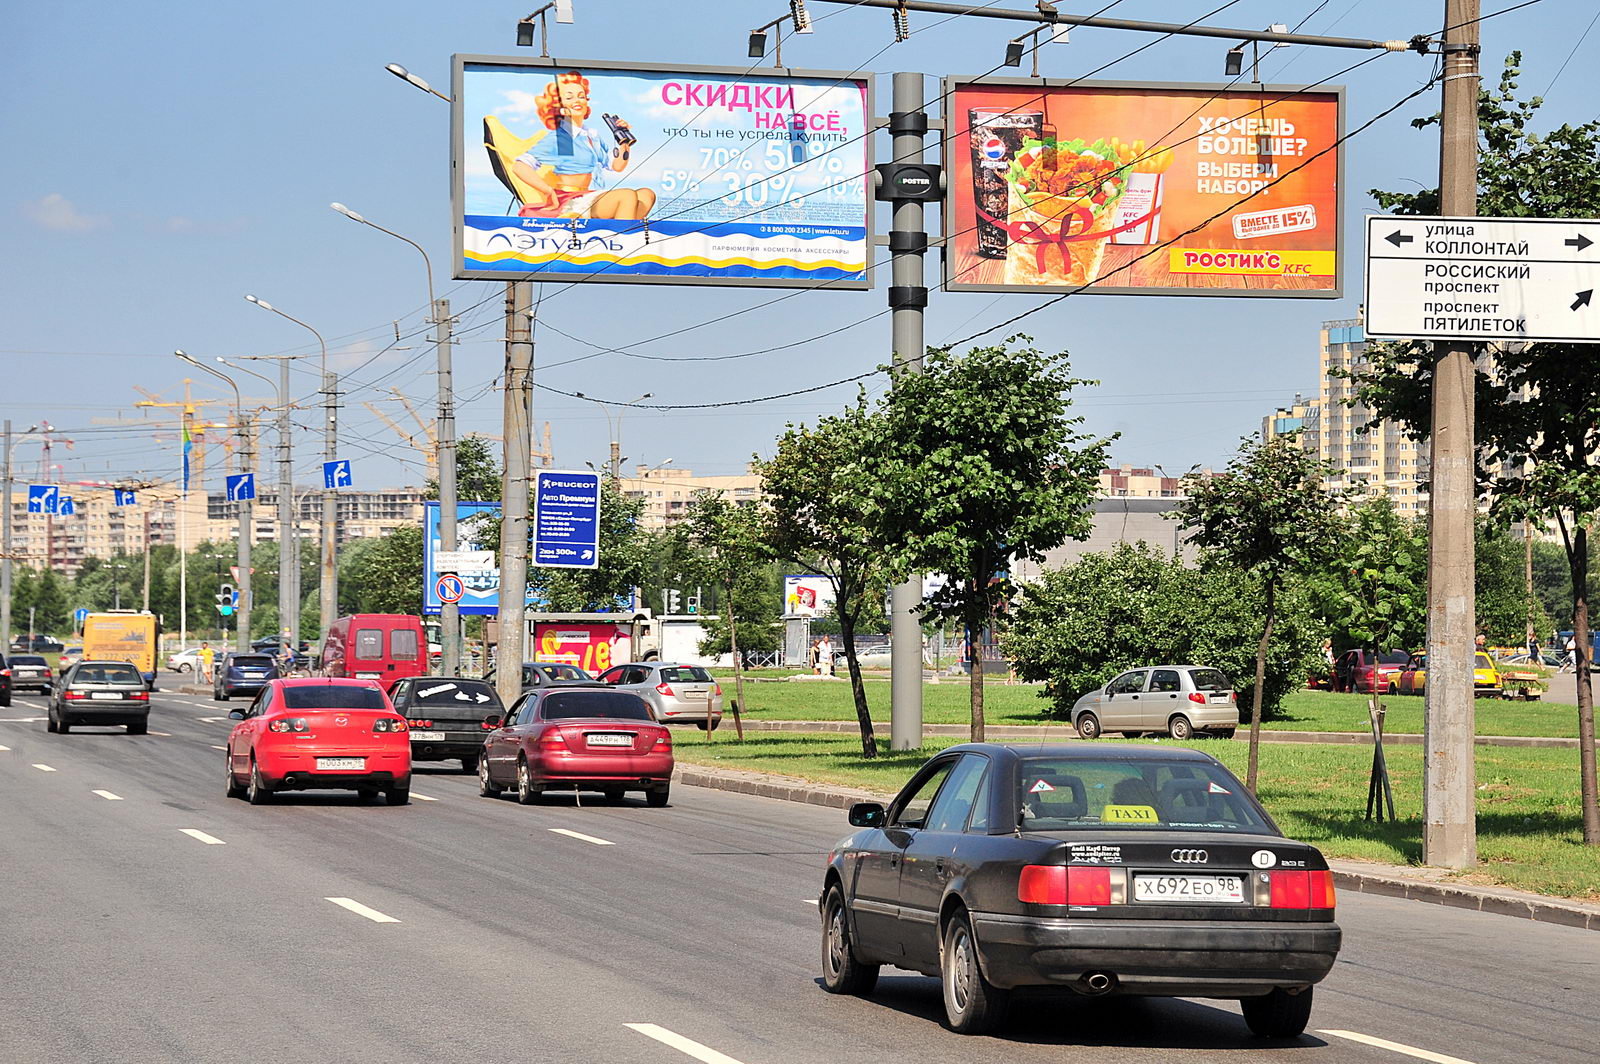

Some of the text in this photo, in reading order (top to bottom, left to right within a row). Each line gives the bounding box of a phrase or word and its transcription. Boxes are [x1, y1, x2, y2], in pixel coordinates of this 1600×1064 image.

[661, 82, 794, 112] СКИДКИ
[755, 110, 847, 135] НА ВСЁ,
[1197, 116, 1295, 136] ХОЧЕШЬ
[663, 128, 847, 143] что ты не успела купить
[1197, 136, 1308, 156] БОЛЬШЕ?
[700, 139, 843, 173] 70% 50%
[1197, 162, 1278, 178] ВЫБЕРИ
[660, 169, 700, 192] 5%
[720, 172, 806, 208] 30%
[1197, 179, 1269, 195] НАБОР!
[1240, 214, 1279, 228] ВМЕСТЕ
[1282, 211, 1311, 227] 15%
[1425, 225, 1474, 238] улица
[1425, 240, 1529, 256] КОЛЛОНТАЙ
[1283, 264, 1312, 274] KFC
[1425, 264, 1530, 279] РОССИСКИЙ
[1424, 281, 1500, 294] проспект
[1424, 302, 1499, 315] проспект
[1424, 317, 1526, 332] ПЯТИЛЕТОК
[1112, 809, 1151, 819] TAXI
[1260, 853, 1268, 865] D
[1217, 878, 1235, 892] 98
